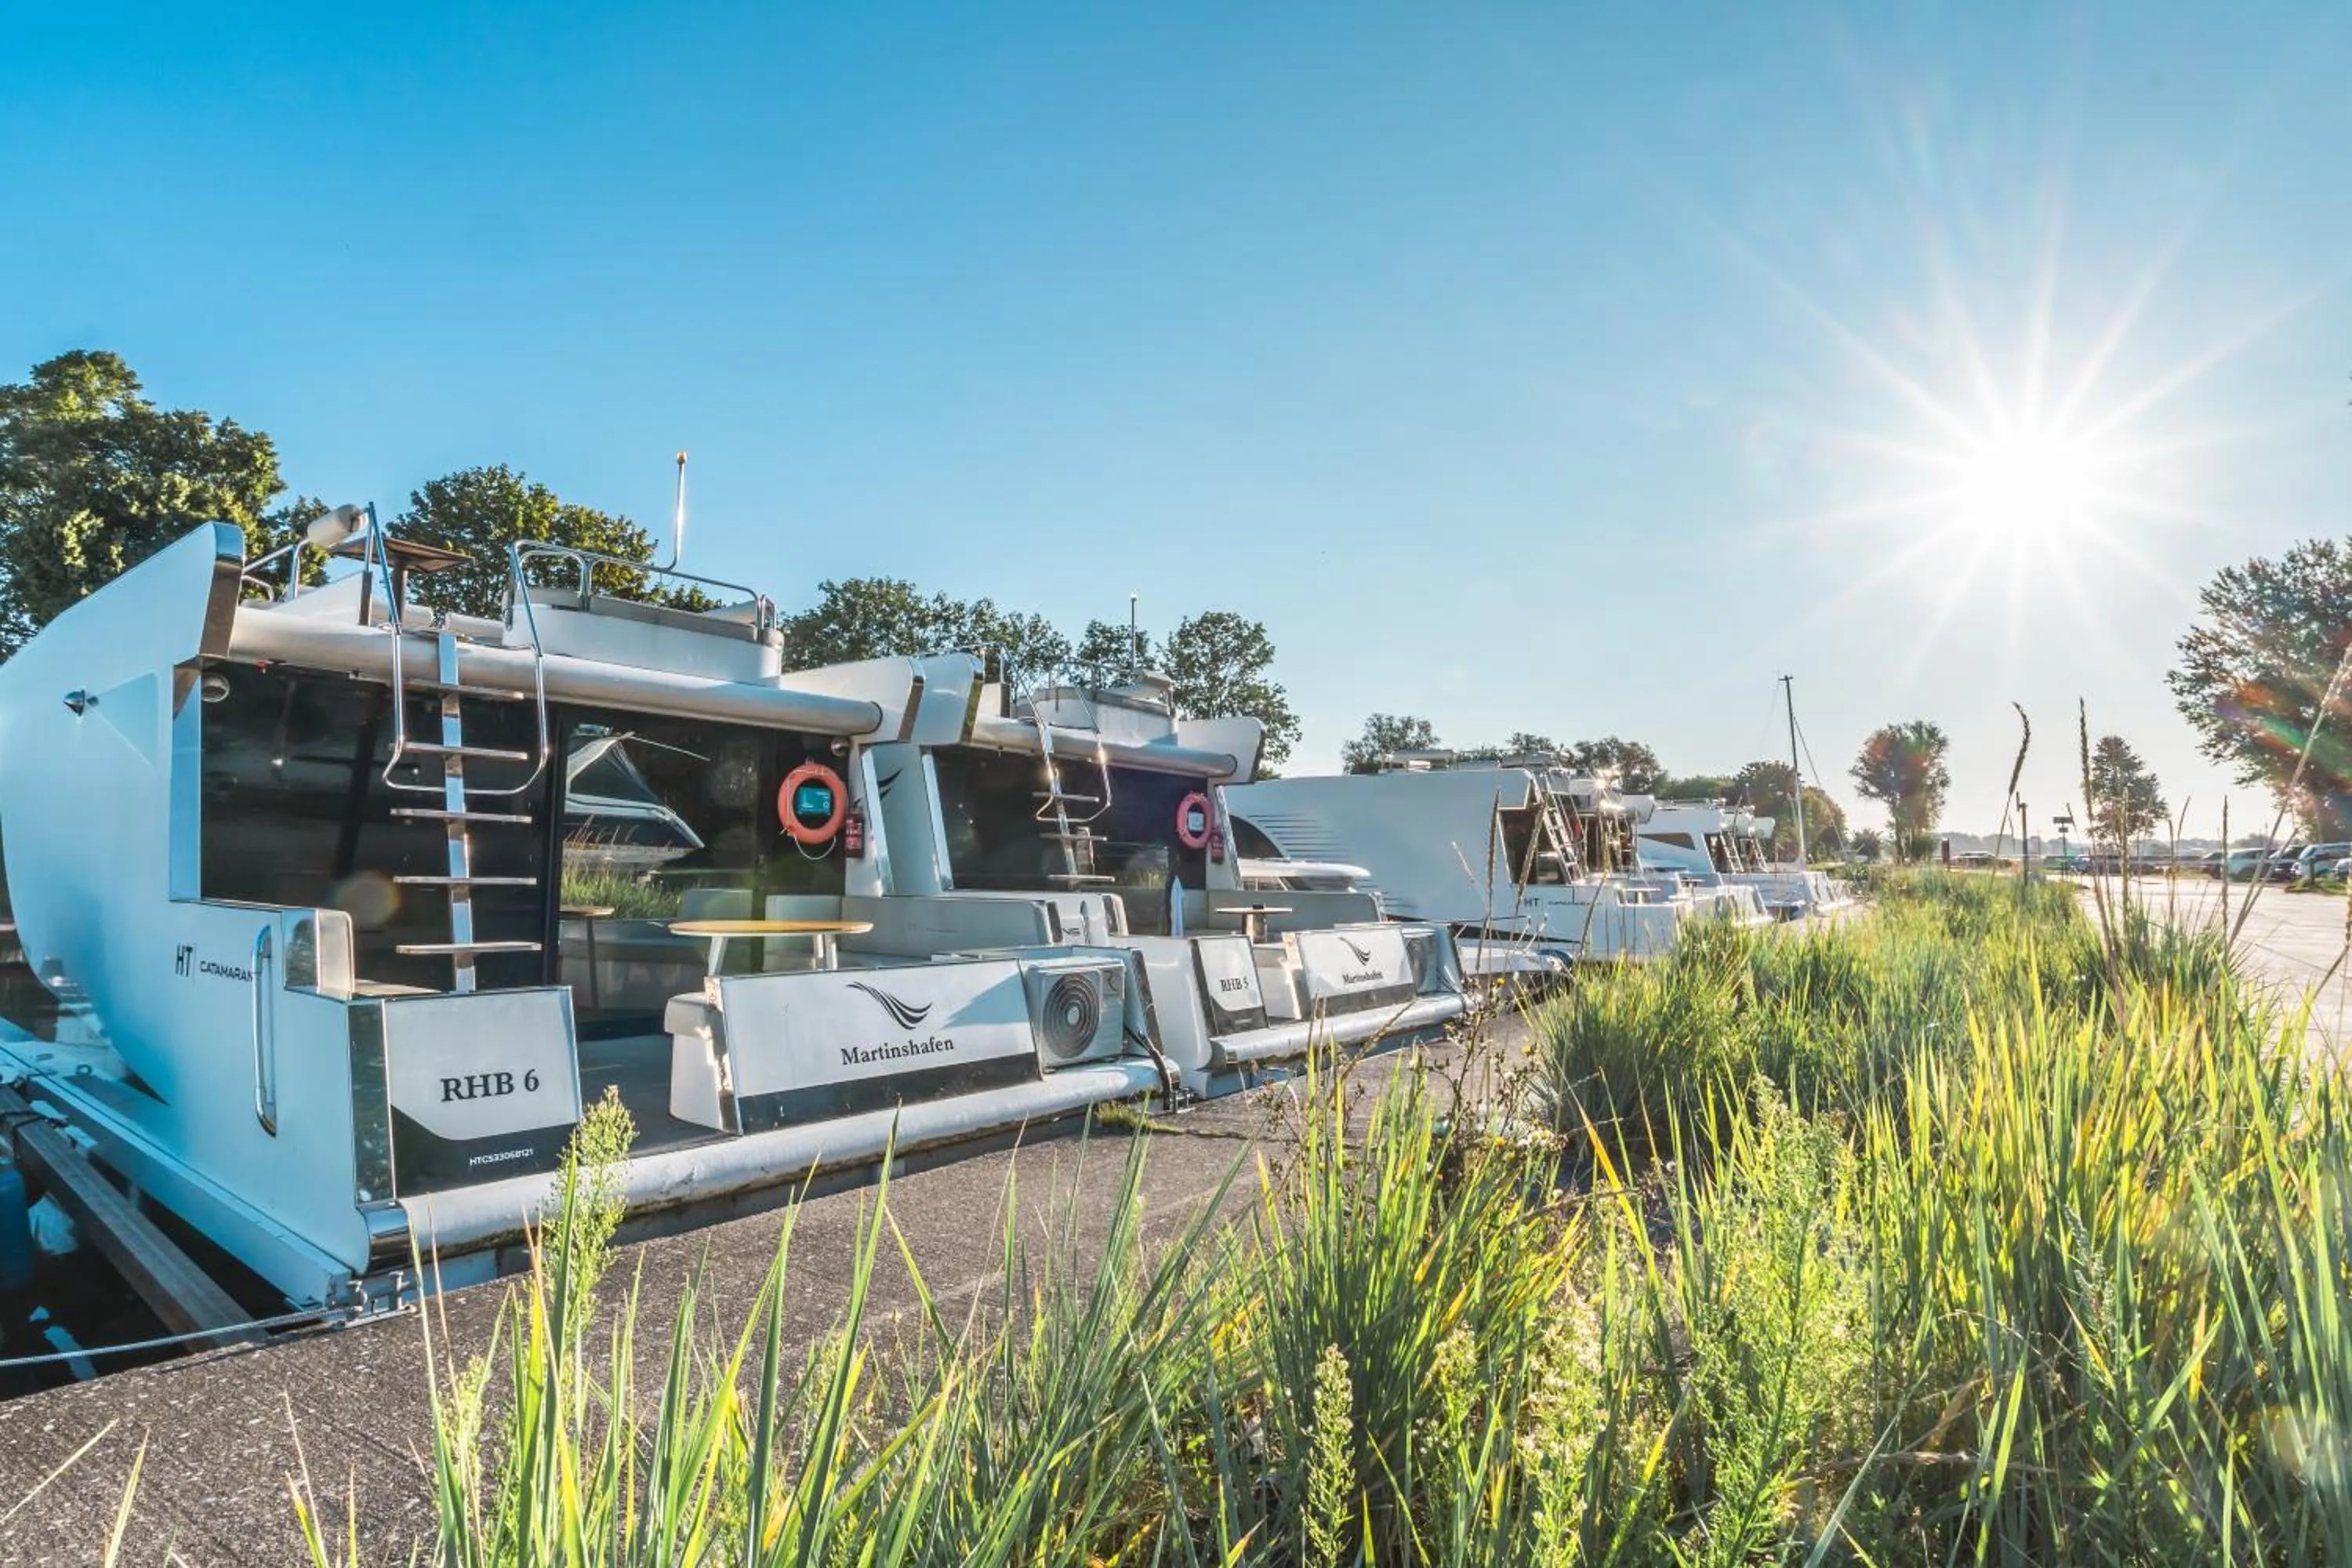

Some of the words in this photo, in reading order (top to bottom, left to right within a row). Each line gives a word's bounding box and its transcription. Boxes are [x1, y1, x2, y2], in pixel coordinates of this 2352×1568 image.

[175, 944, 194, 978] HT
[840, 1036, 955, 1065] Martinshafen
[440, 1071, 515, 1103] RHB
[524, 1068, 540, 1092] 6
